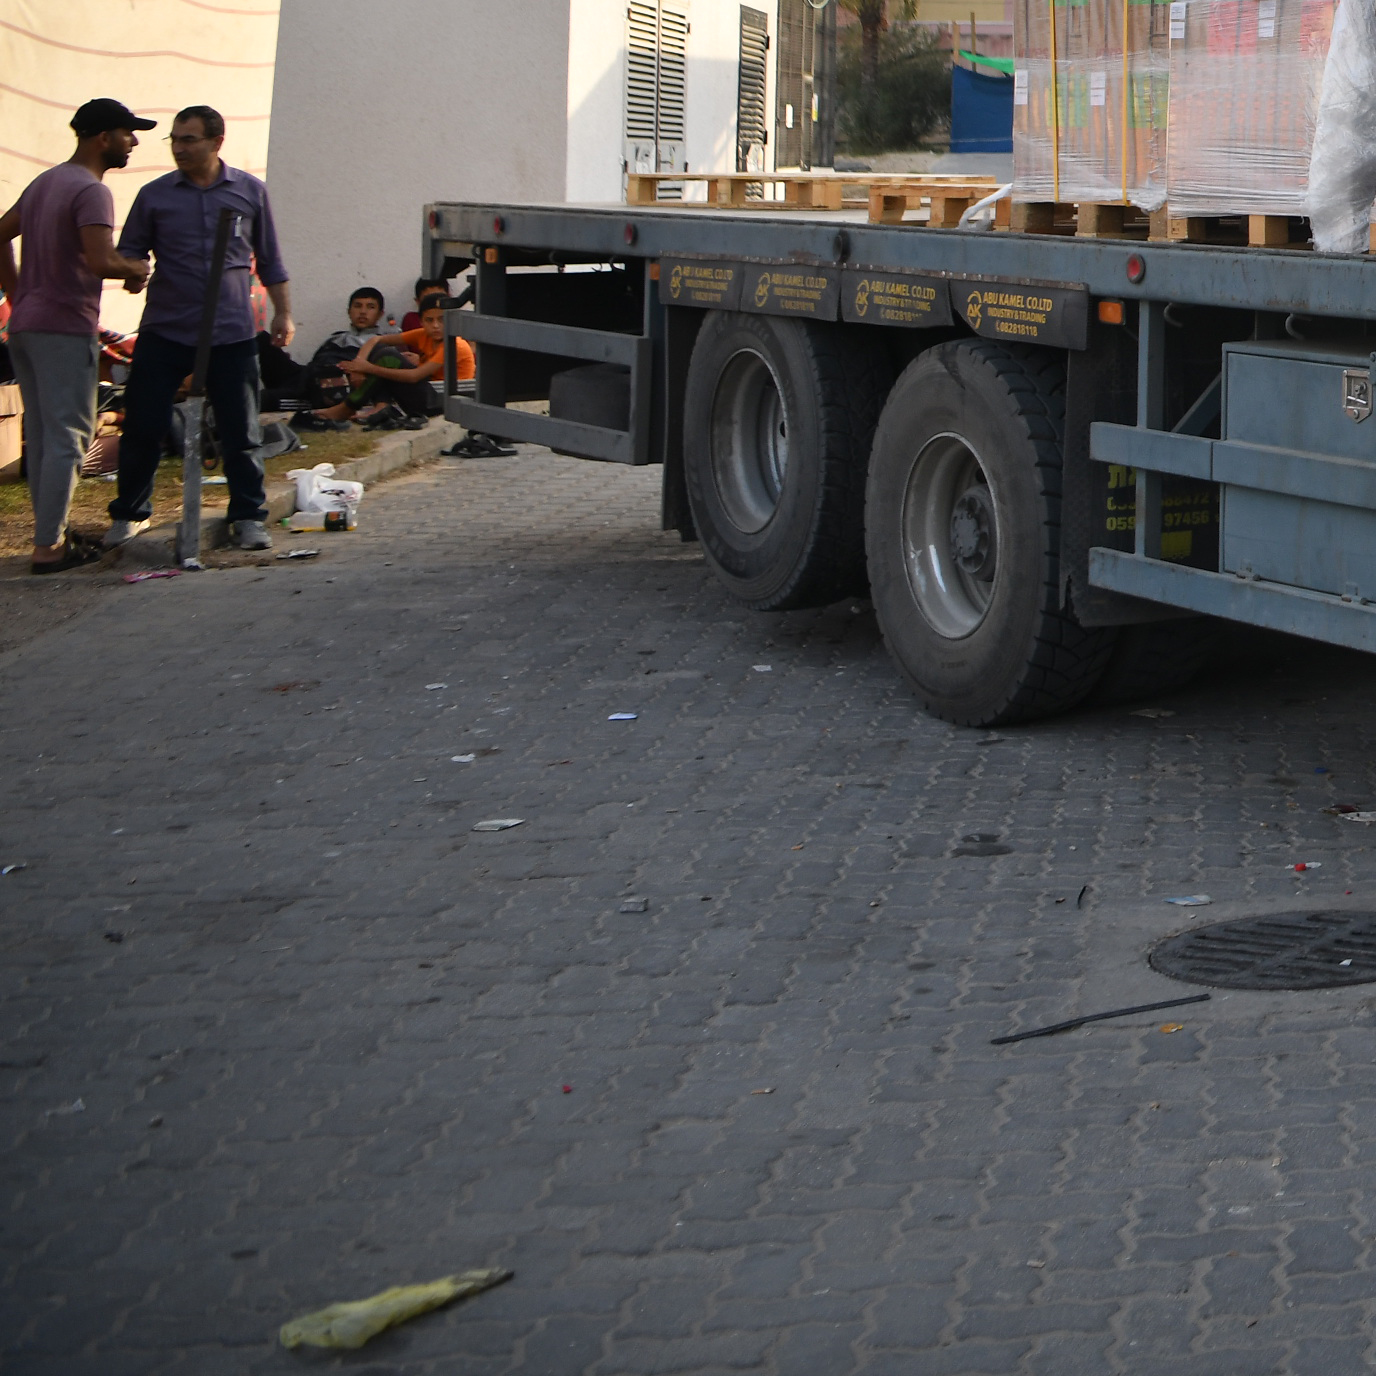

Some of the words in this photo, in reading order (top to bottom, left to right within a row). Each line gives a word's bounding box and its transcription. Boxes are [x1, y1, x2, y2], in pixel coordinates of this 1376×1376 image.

[885, 282, 910, 296] KAMEL
[983, 291, 999, 305] ABU
[999, 293, 1025, 310] KAMEL
[1026, 297, 1053, 312] CO.LTD
